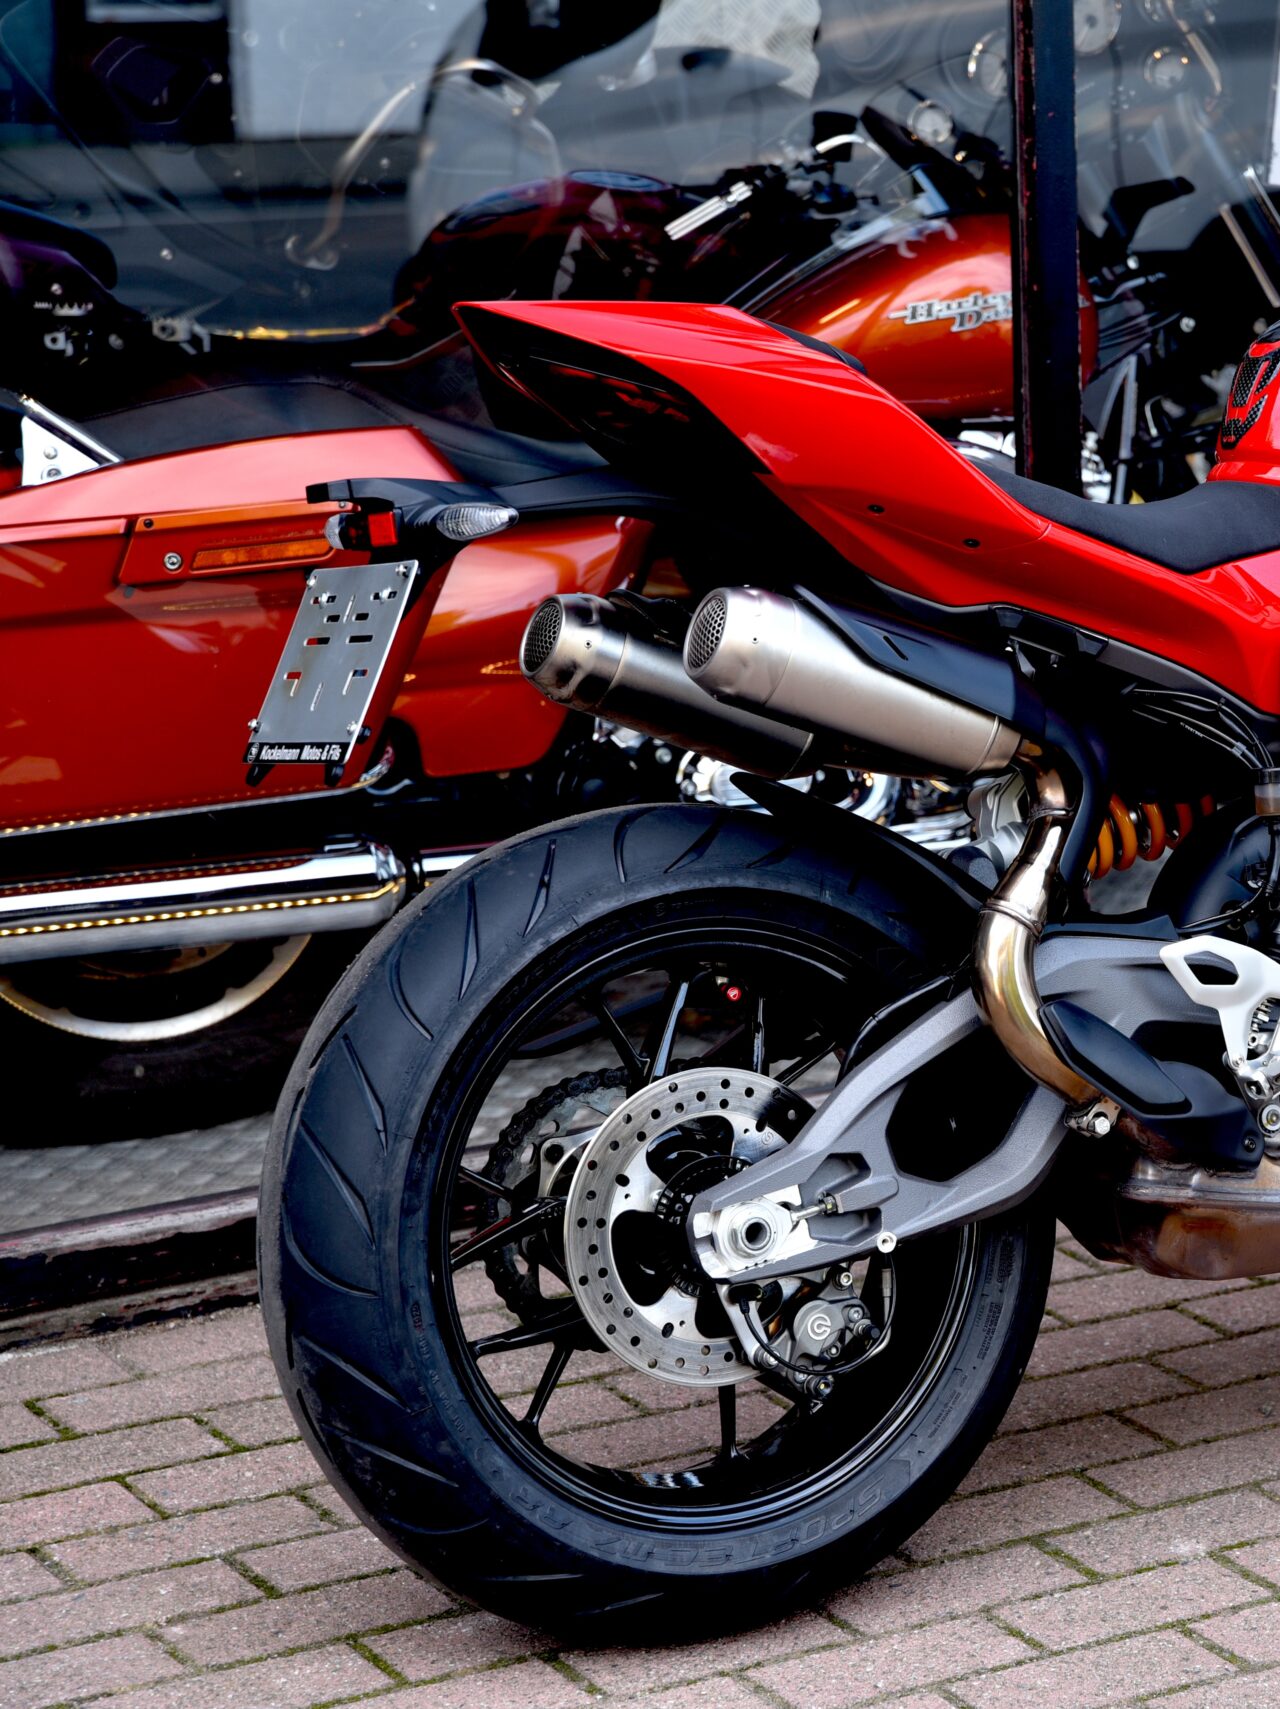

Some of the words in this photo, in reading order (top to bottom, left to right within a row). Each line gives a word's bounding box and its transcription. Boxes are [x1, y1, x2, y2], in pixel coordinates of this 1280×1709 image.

[259, 745, 300, 761] Kockelmann
[300, 745, 322, 761] Motos
[321, 744, 330, 761] &
[327, 744, 342, 761] Fils
[663, 1473, 885, 1567] SPORTEC
